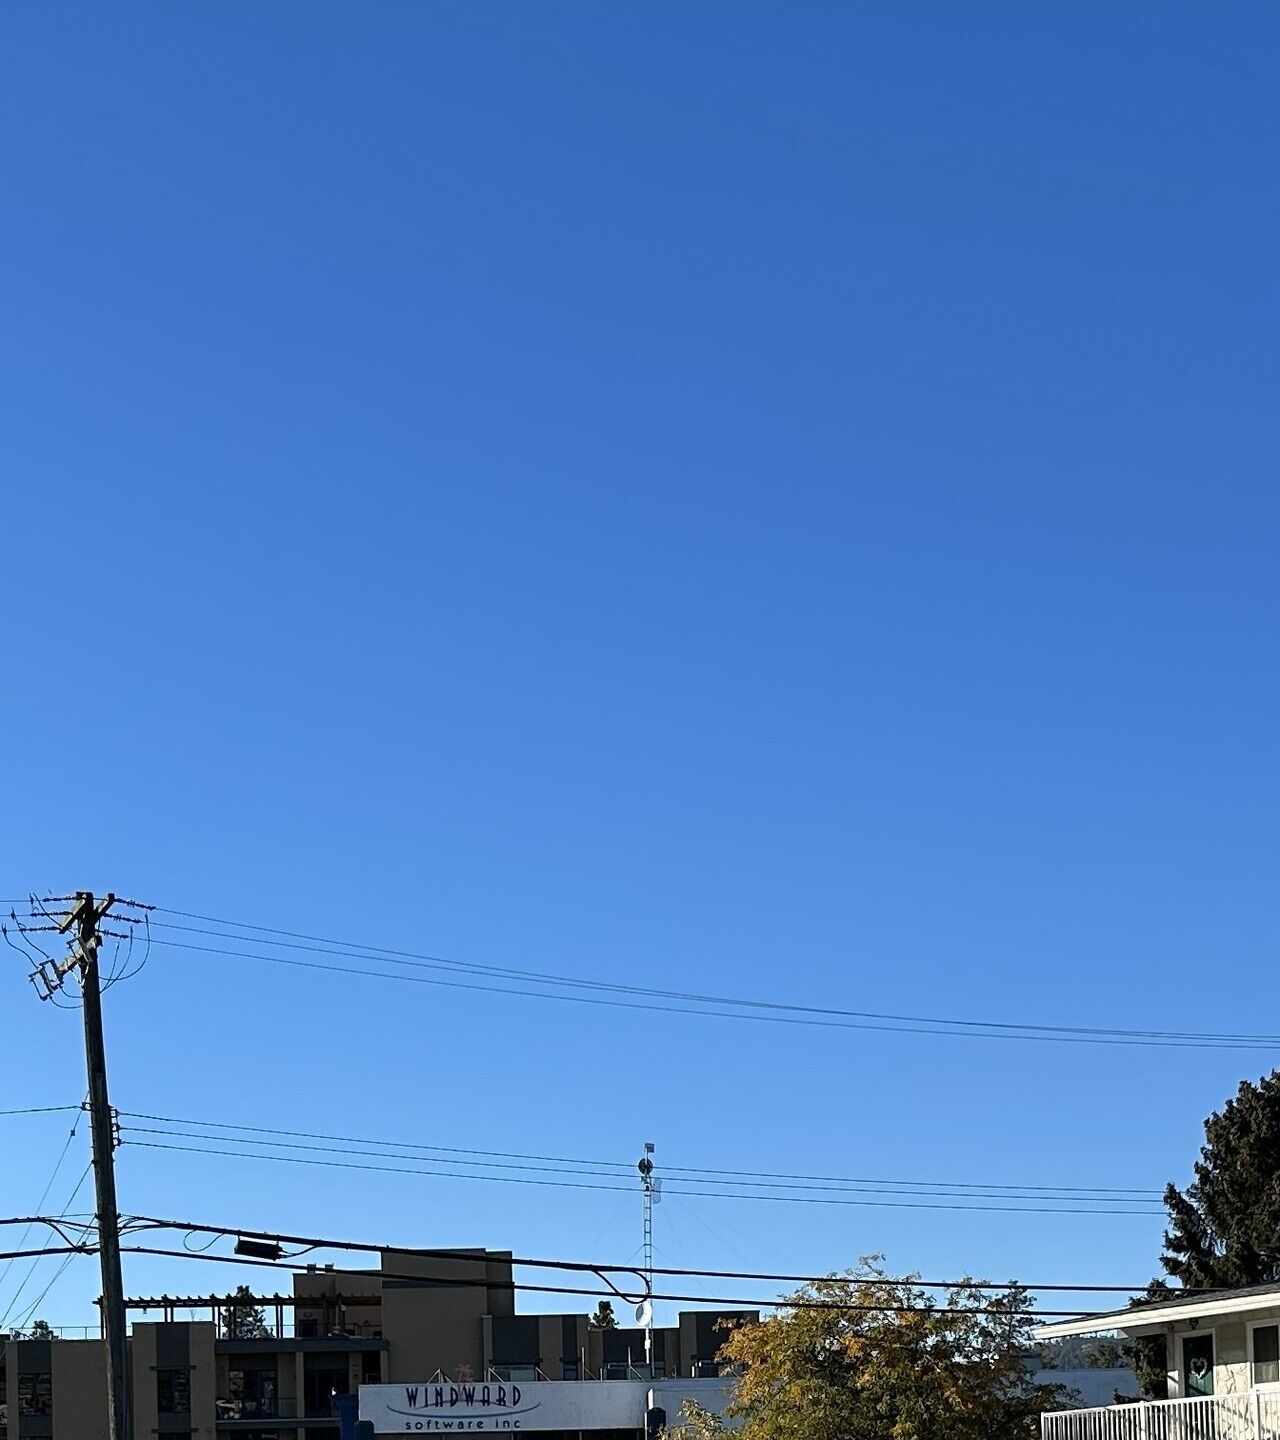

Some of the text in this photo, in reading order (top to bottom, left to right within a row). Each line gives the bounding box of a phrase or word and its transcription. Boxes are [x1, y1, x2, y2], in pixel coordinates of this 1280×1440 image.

[405, 1385, 521, 1408] WINDWARD
[405, 1418, 521, 1430] software inc
